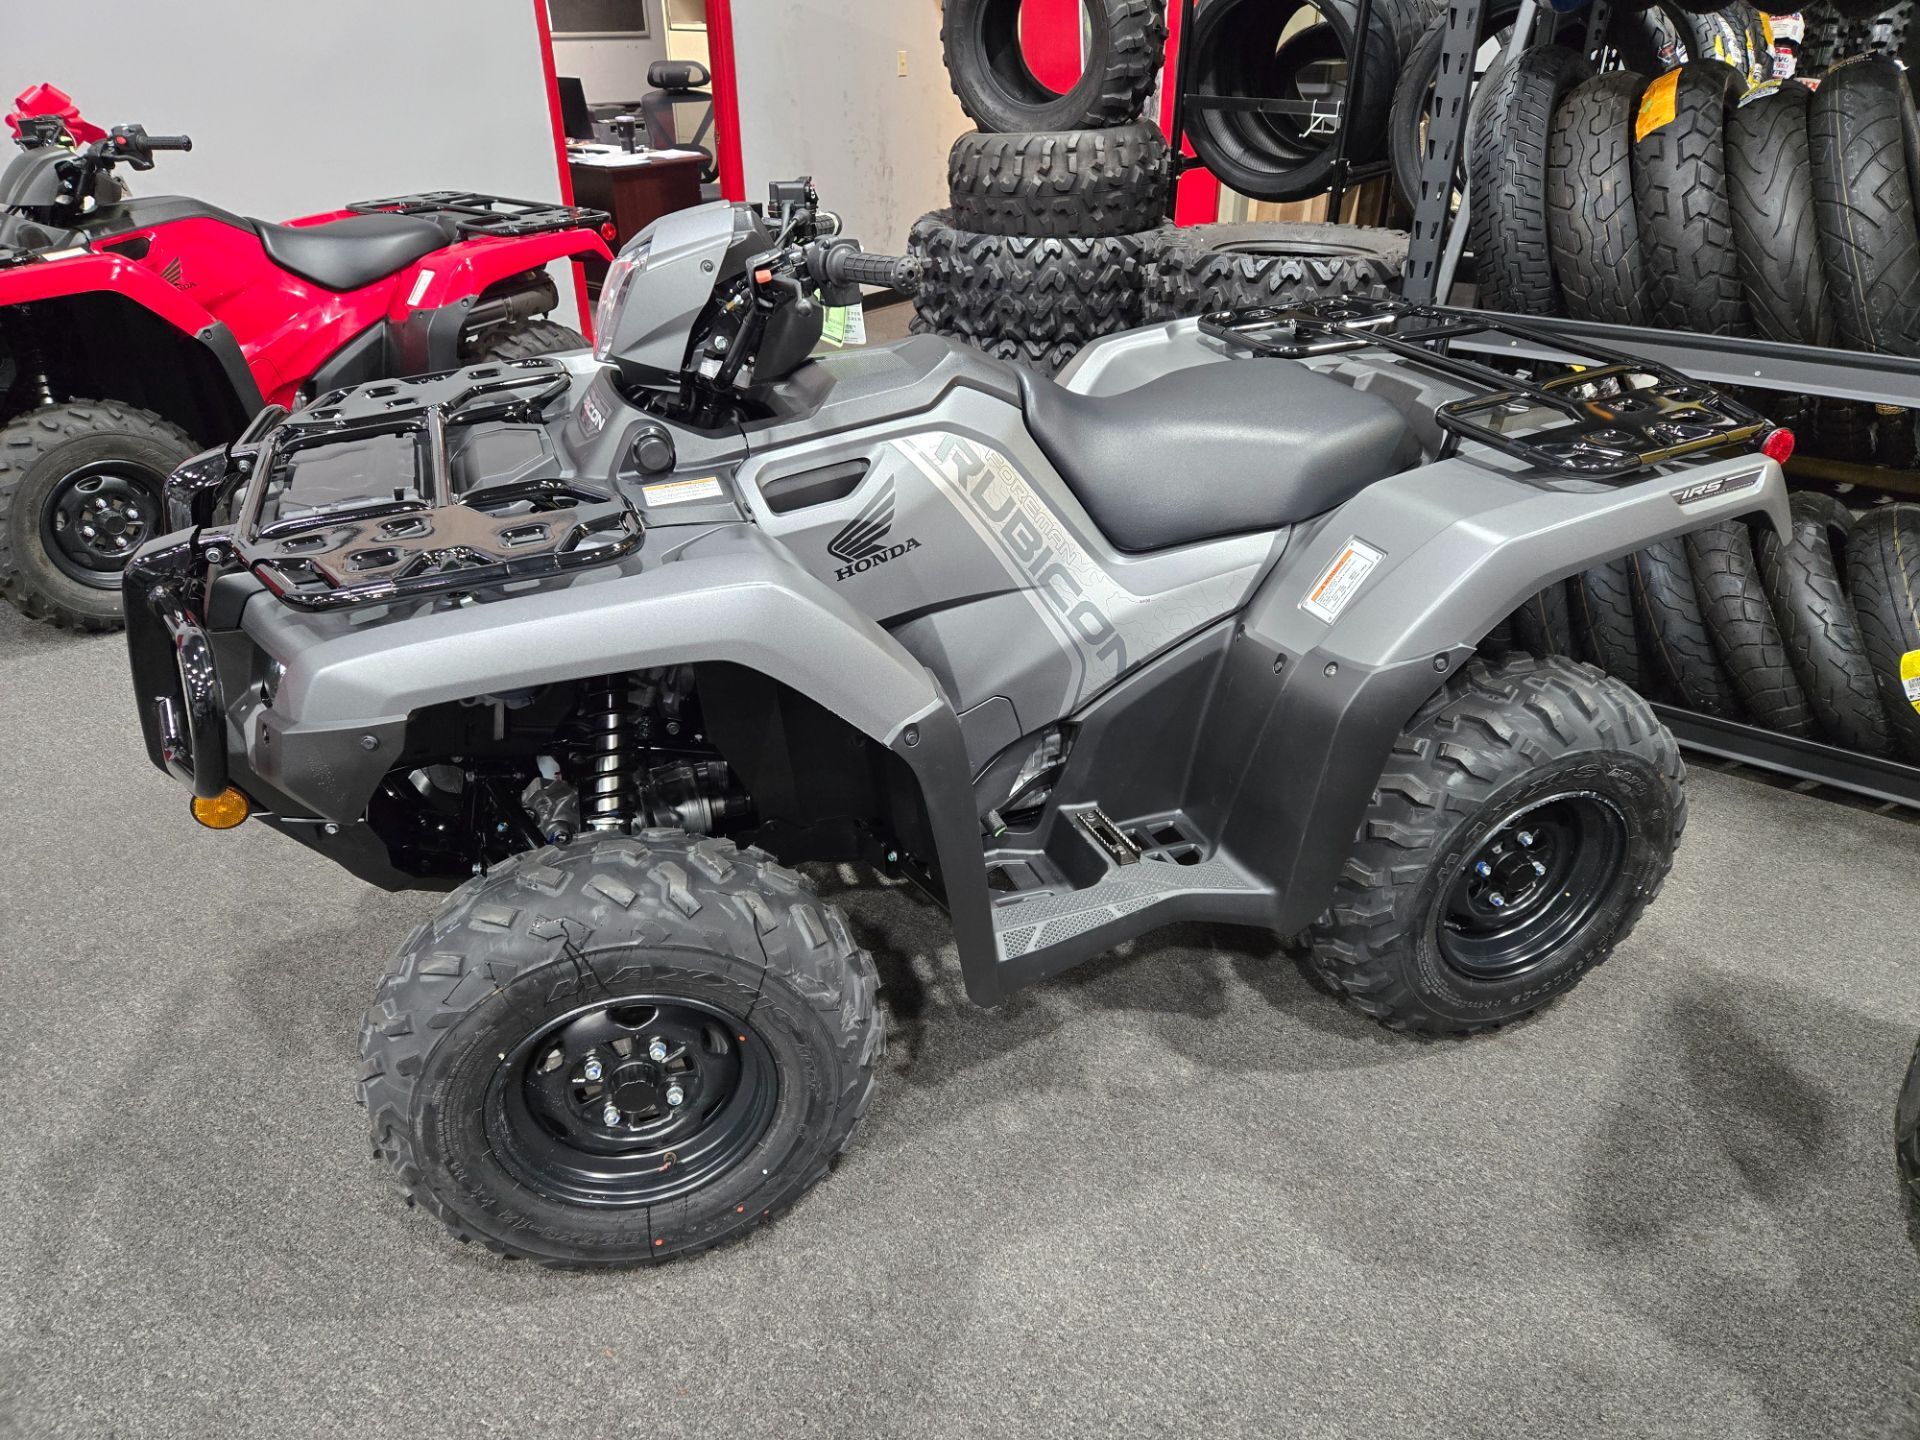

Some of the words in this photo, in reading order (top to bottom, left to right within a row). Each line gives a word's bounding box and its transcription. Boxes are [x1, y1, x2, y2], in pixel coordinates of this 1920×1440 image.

[984, 447, 1080, 566] FOREMAN
[1681, 480, 1724, 499] IRS
[835, 537, 922, 582] HONDA
[935, 434, 1128, 680] RUBICON
